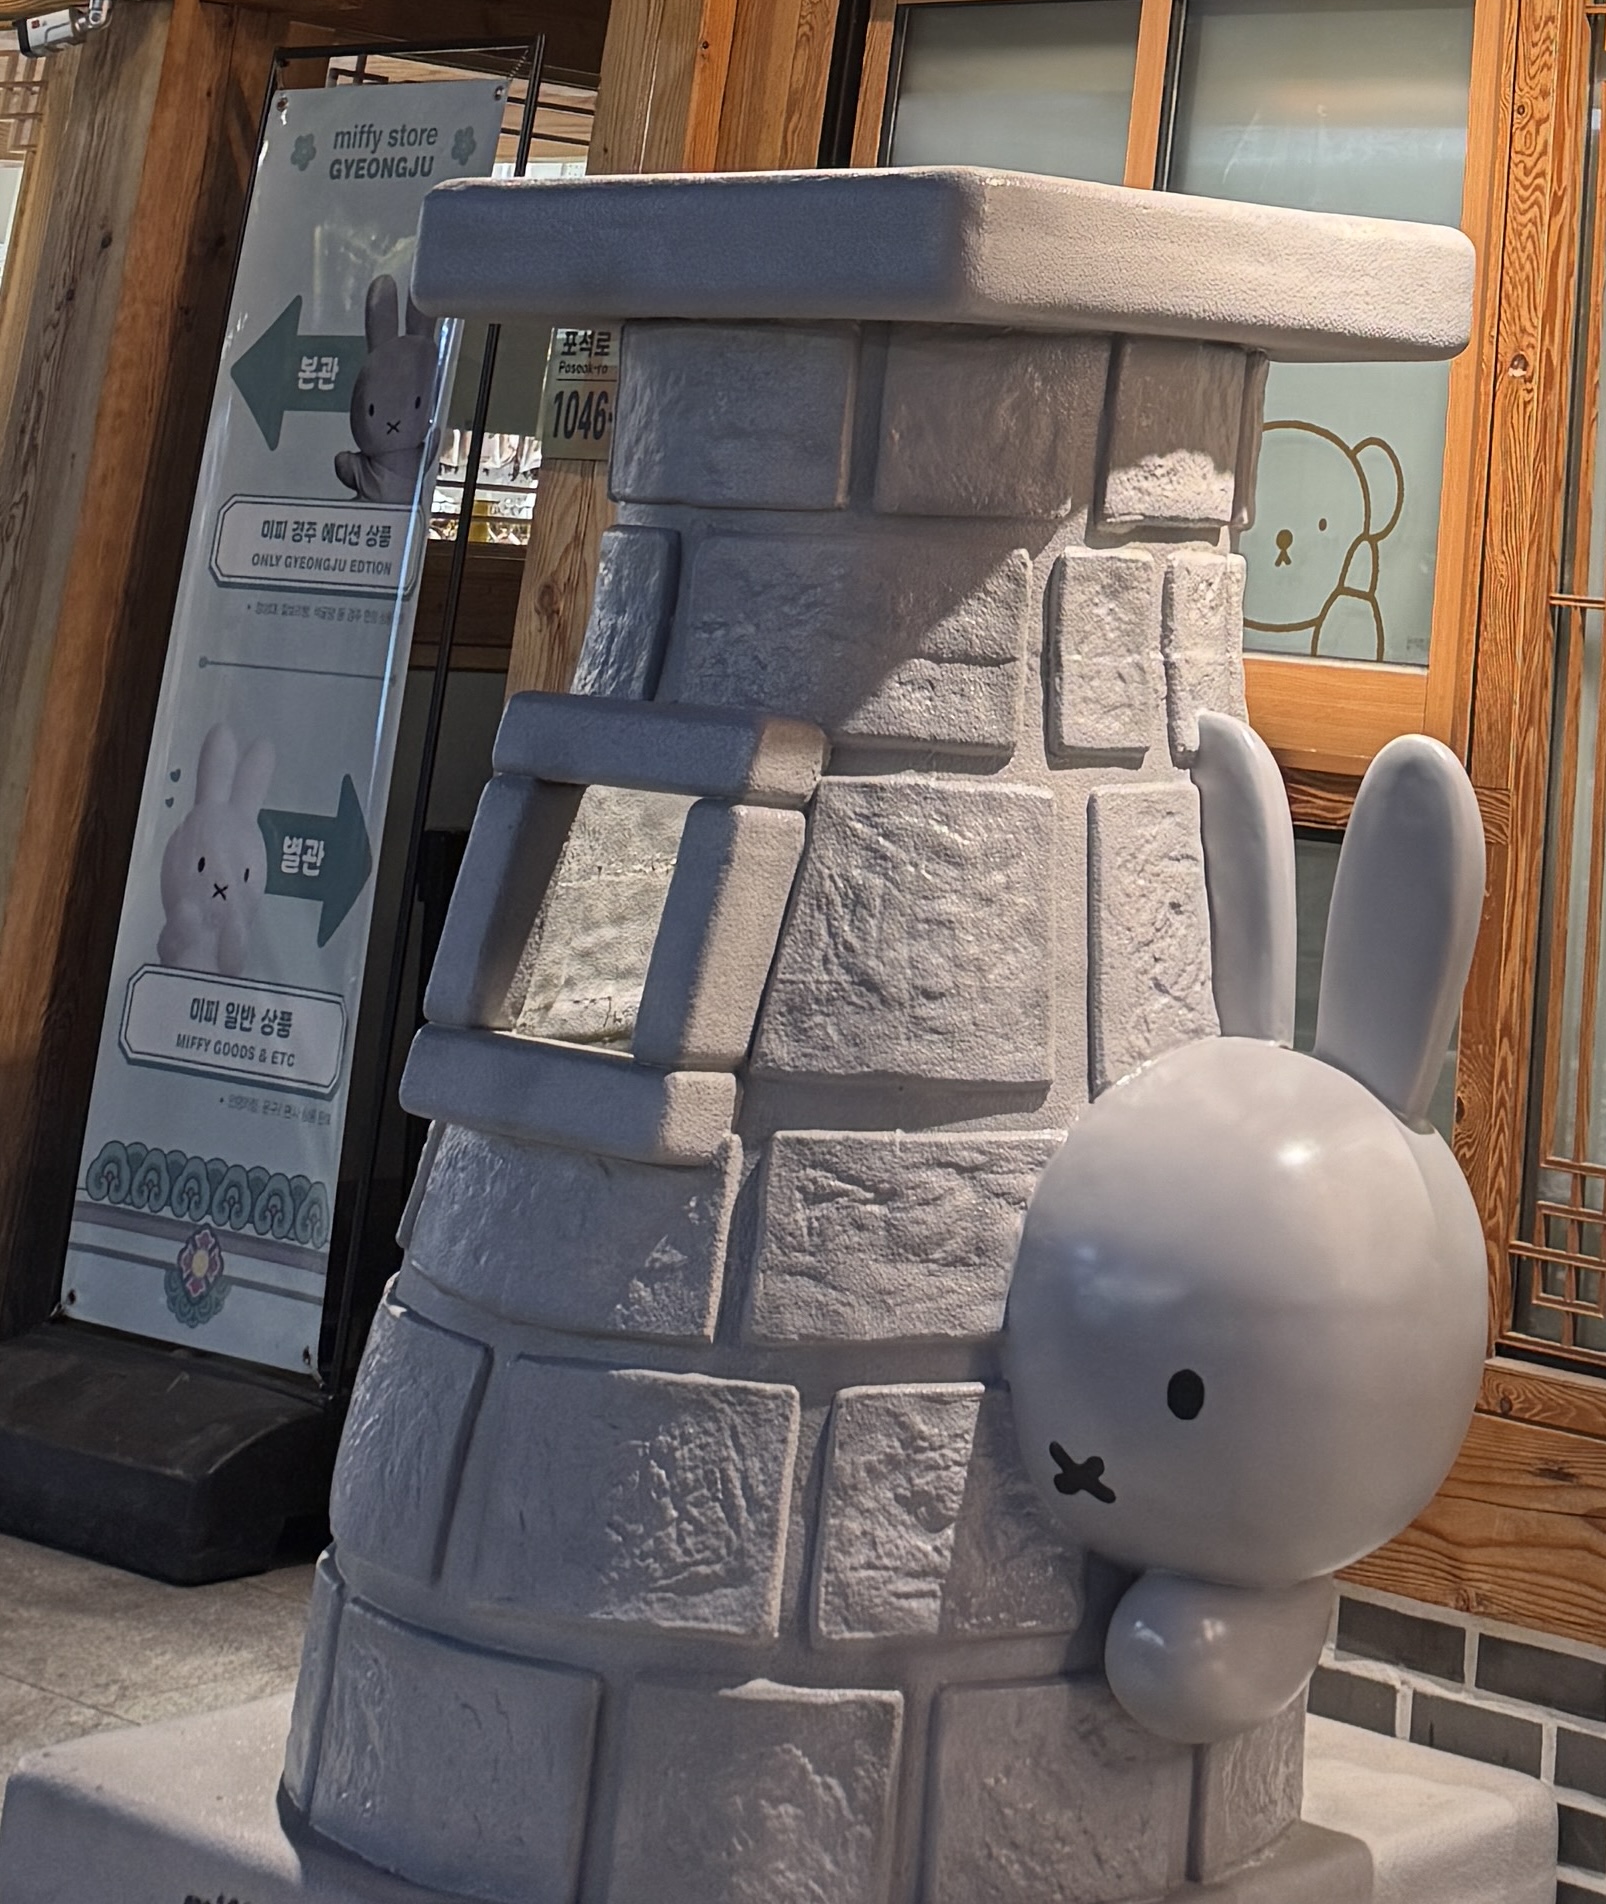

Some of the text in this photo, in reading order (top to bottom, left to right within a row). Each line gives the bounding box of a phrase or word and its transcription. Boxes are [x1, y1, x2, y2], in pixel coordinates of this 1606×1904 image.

[333, 123, 438, 154] miffy store
[329, 155, 434, 180] GYEONGJU
[561, 330, 612, 358] 포석로
[298, 355, 340, 391] 본관
[261, 519, 392, 549] 미피 경주 에디션 상품
[251, 552, 392, 576] ONLY GYEONGJU EDTION
[281, 835, 325, 876] 별관
[190, 997, 293, 1039] 미피 일반 상품
[176, 1033, 296, 1068] MIFFY GOODS & ETC
